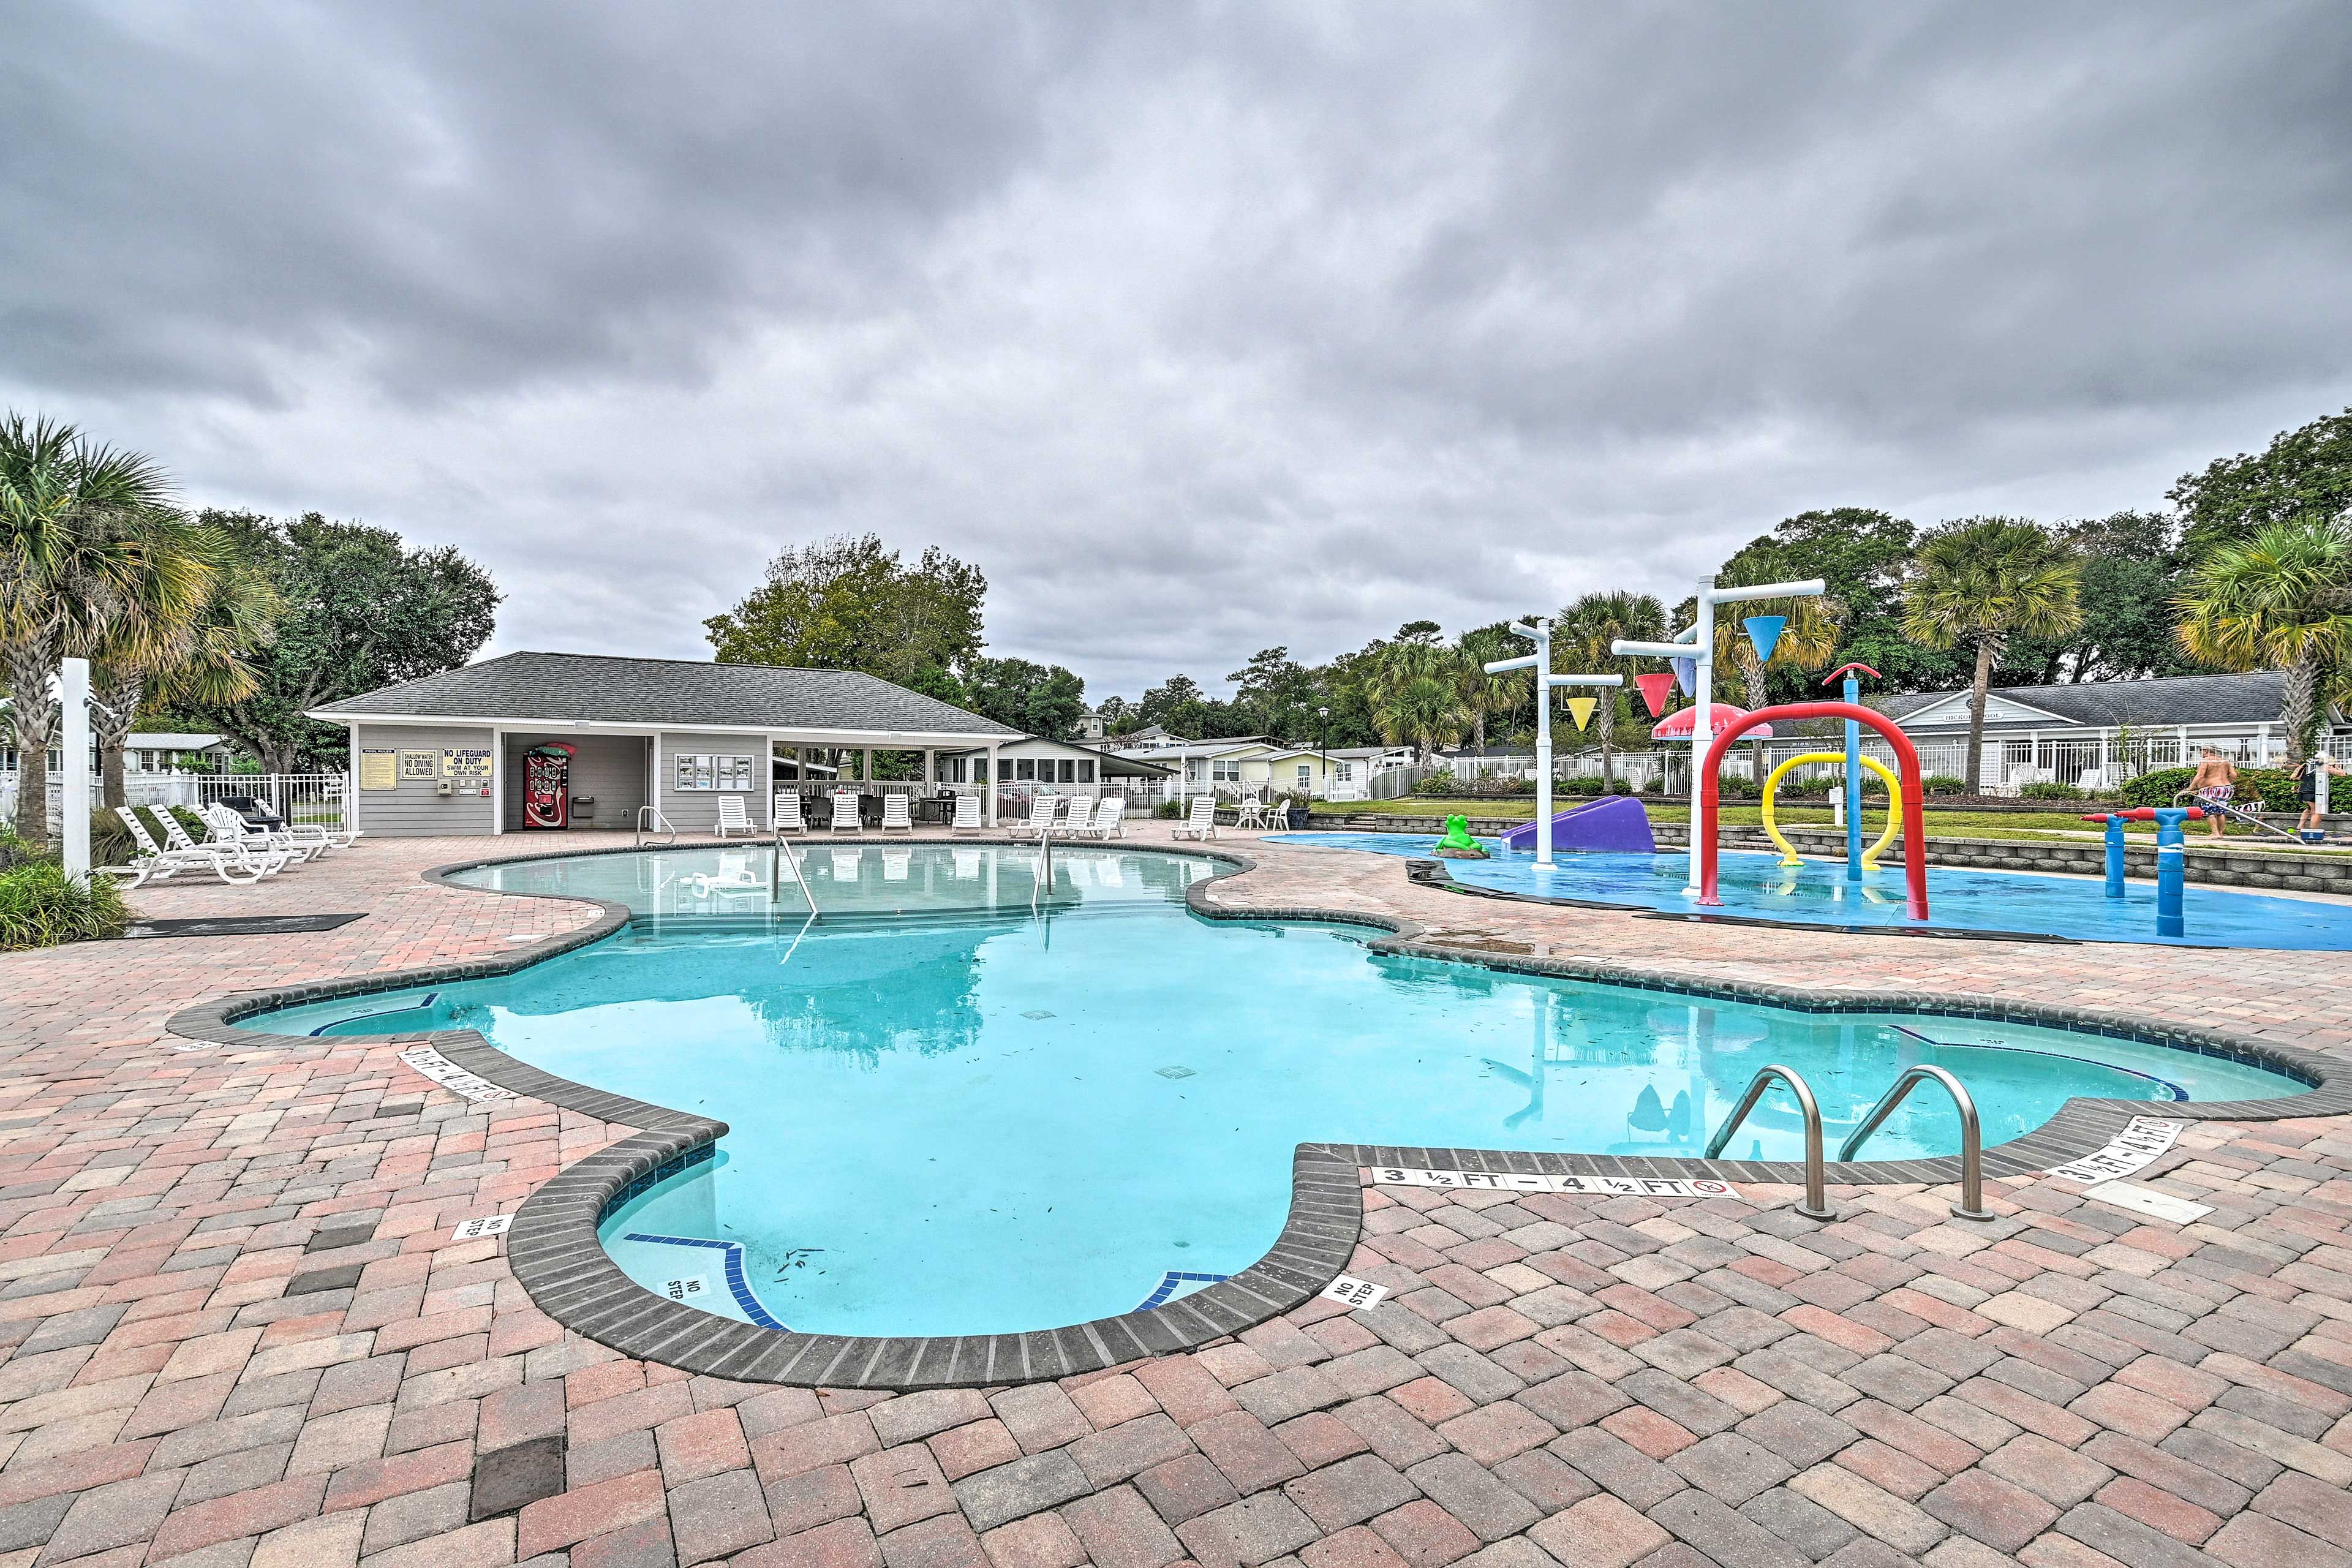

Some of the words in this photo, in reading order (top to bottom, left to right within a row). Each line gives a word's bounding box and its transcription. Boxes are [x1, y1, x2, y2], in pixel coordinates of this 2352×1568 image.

[2132, 1125, 2171, 1138] FT
[2120, 1140, 2158, 1150] 4
[2090, 1155, 2136, 1170] FT
[2057, 1169, 2095, 1180] 3
[1384, 1169, 1406, 1181] 3
[1463, 1173, 1499, 1187] FT
[1562, 1177, 1586, 1190] 4
[1642, 1179, 1683, 1194] FT
[466, 1219, 485, 1236] STEP
[487, 1219, 504, 1229] NO
[668, 1280, 684, 1299] STEP
[686, 1280, 701, 1292] NO
[1333, 1283, 1354, 1295] NO
[1349, 1283, 1375, 1305] STEP
